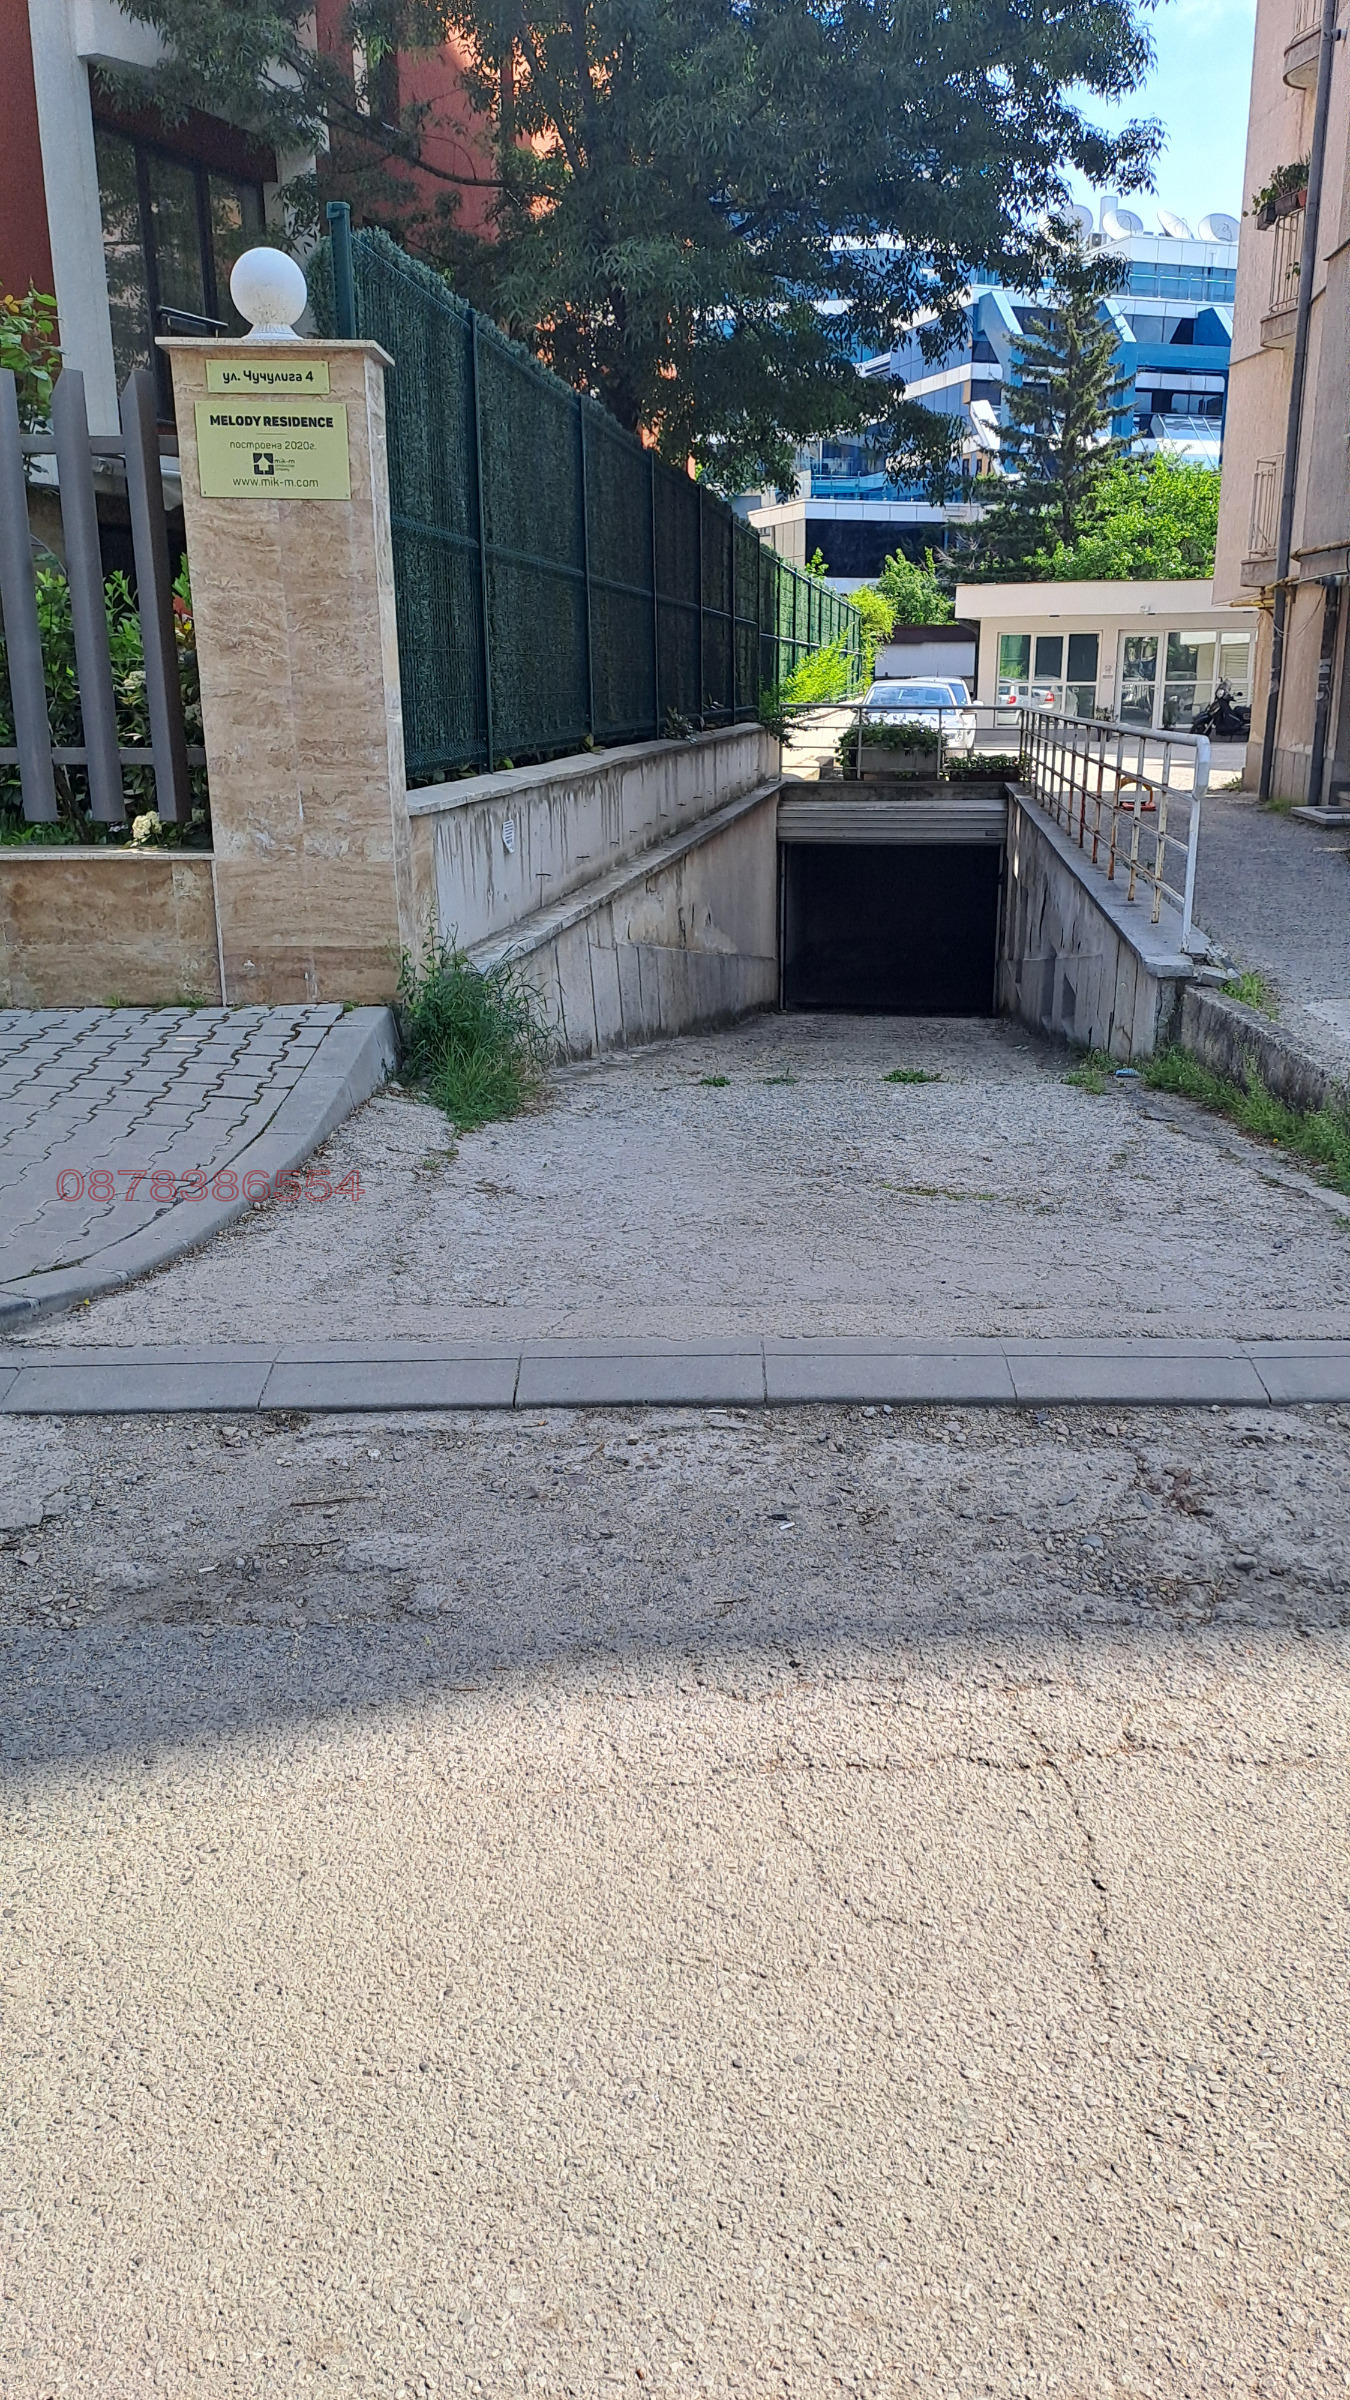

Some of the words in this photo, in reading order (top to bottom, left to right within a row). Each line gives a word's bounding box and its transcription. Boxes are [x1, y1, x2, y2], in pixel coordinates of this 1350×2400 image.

[222, 372, 241, 384] ул.
[243, 370, 303, 384] Чучулига
[305, 370, 314, 382] 4
[209, 414, 261, 427] MELODY
[263, 416, 334, 428] RESIDENCE
[229, 440, 282, 451] построена
[284, 440, 317, 451] 2020г.
[232, 476, 319, 488] www.mik-m.com
